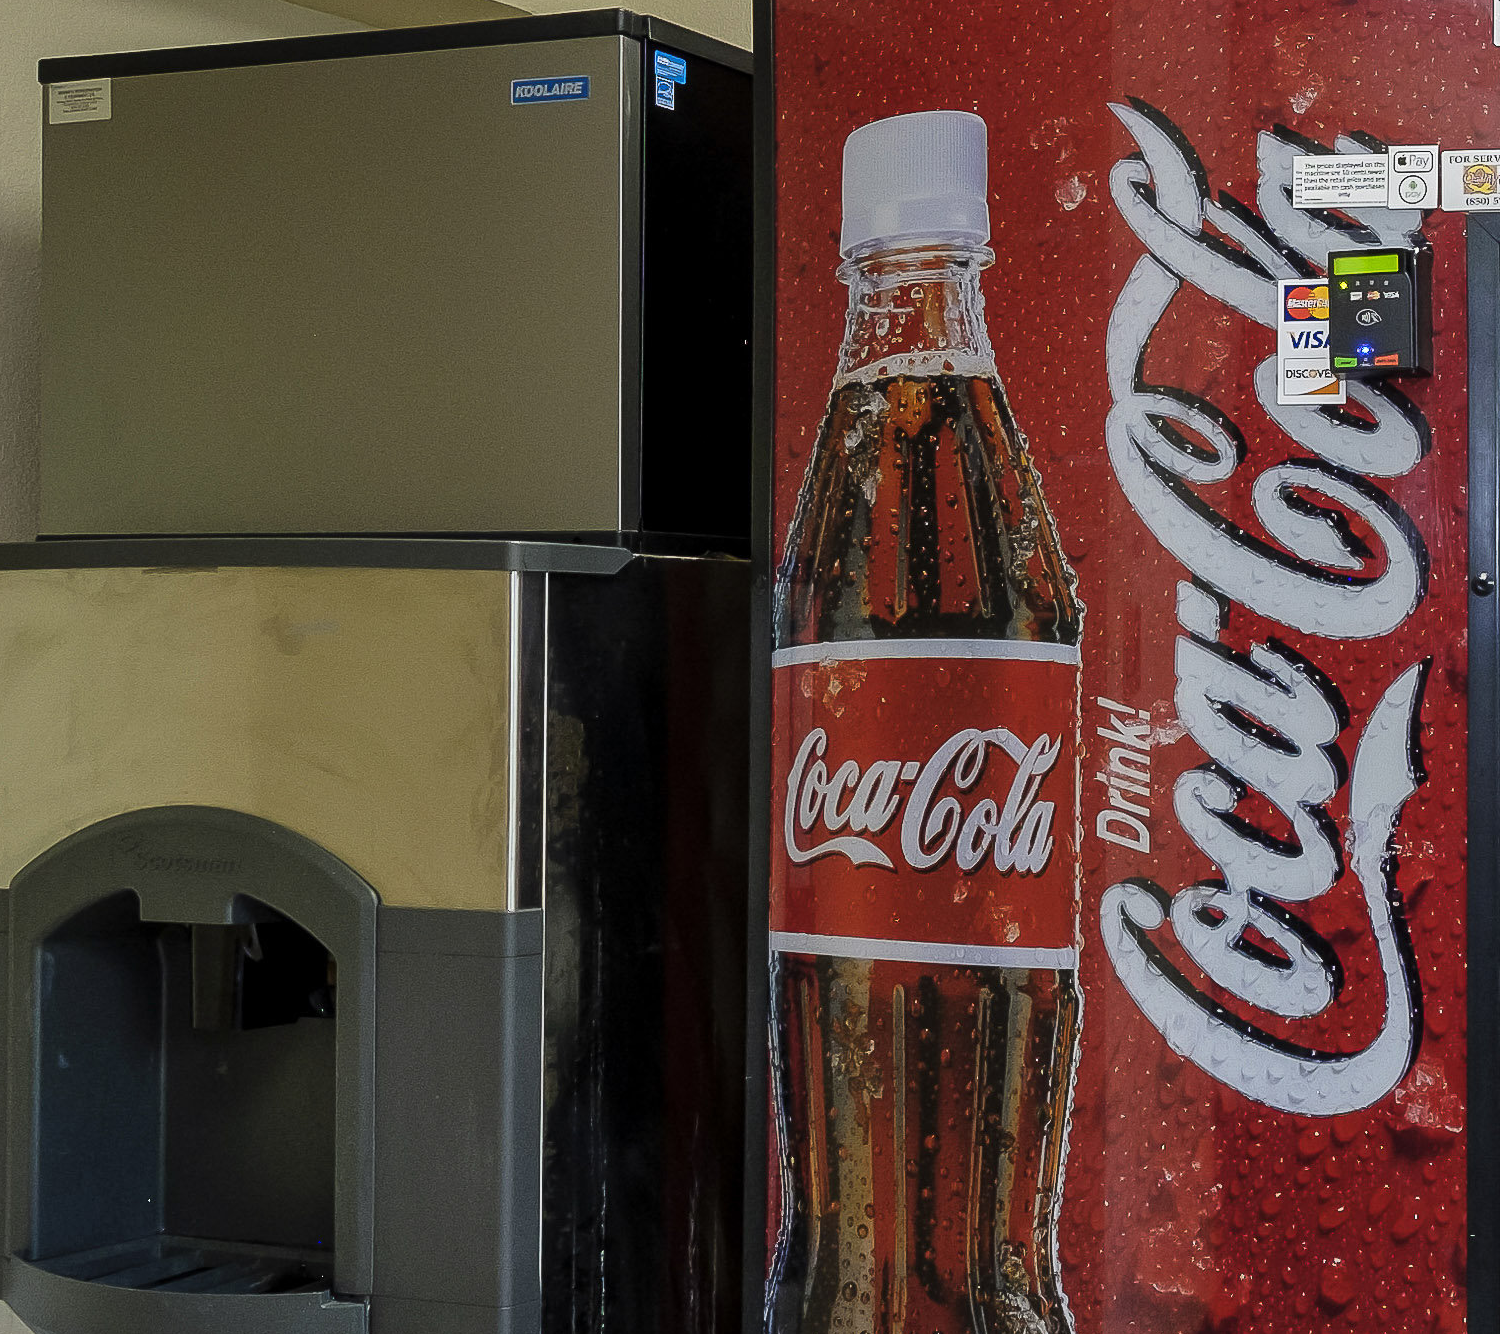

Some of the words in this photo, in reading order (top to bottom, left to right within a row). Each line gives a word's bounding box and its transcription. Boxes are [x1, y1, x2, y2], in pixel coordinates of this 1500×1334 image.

[516, 81, 583, 98] KOOLAIRE
[1409, 155, 1429, 168] Pay
[1450, 156, 1470, 164] FOR
[1466, 197, 1490, 206] (850)
[1099, 97, 1434, 1120] Coca-Cola
[1098, 699, 1152, 854] Drink!
[786, 723, 1062, 878] Coca-Cola
